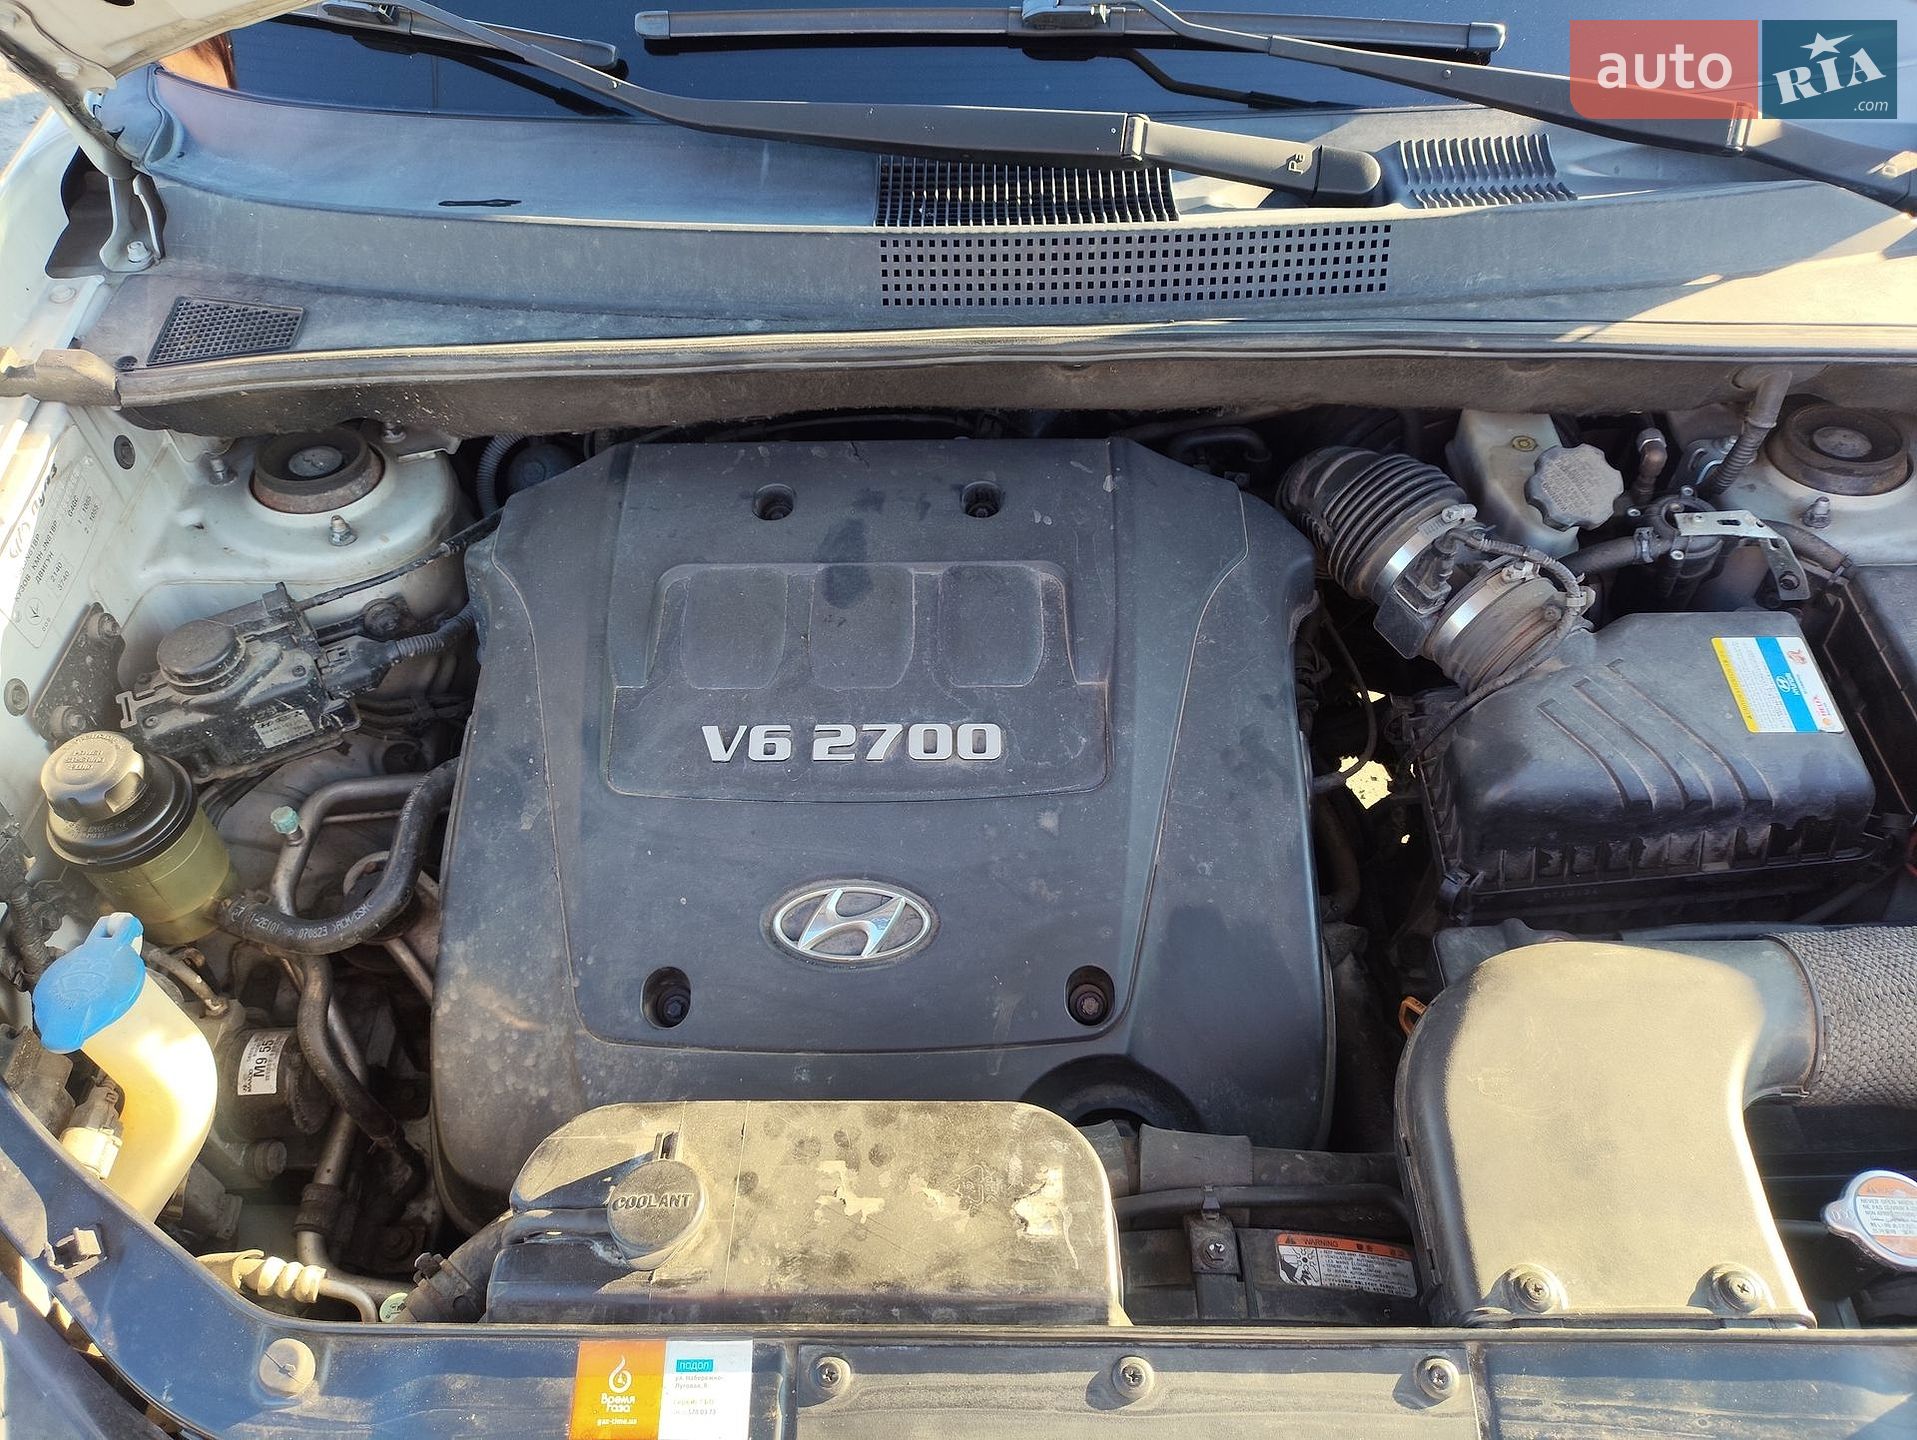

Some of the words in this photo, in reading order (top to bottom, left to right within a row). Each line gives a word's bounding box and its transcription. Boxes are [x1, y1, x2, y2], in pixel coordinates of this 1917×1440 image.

[701, 723, 792, 762] V6
[812, 723, 1002, 761] 2700
[259, 1040, 275, 1053] 55
[253, 1057, 268, 1078] M9
[612, 1193, 694, 1211] COOLANT
[1303, 1238, 1339, 1248] WARNING
